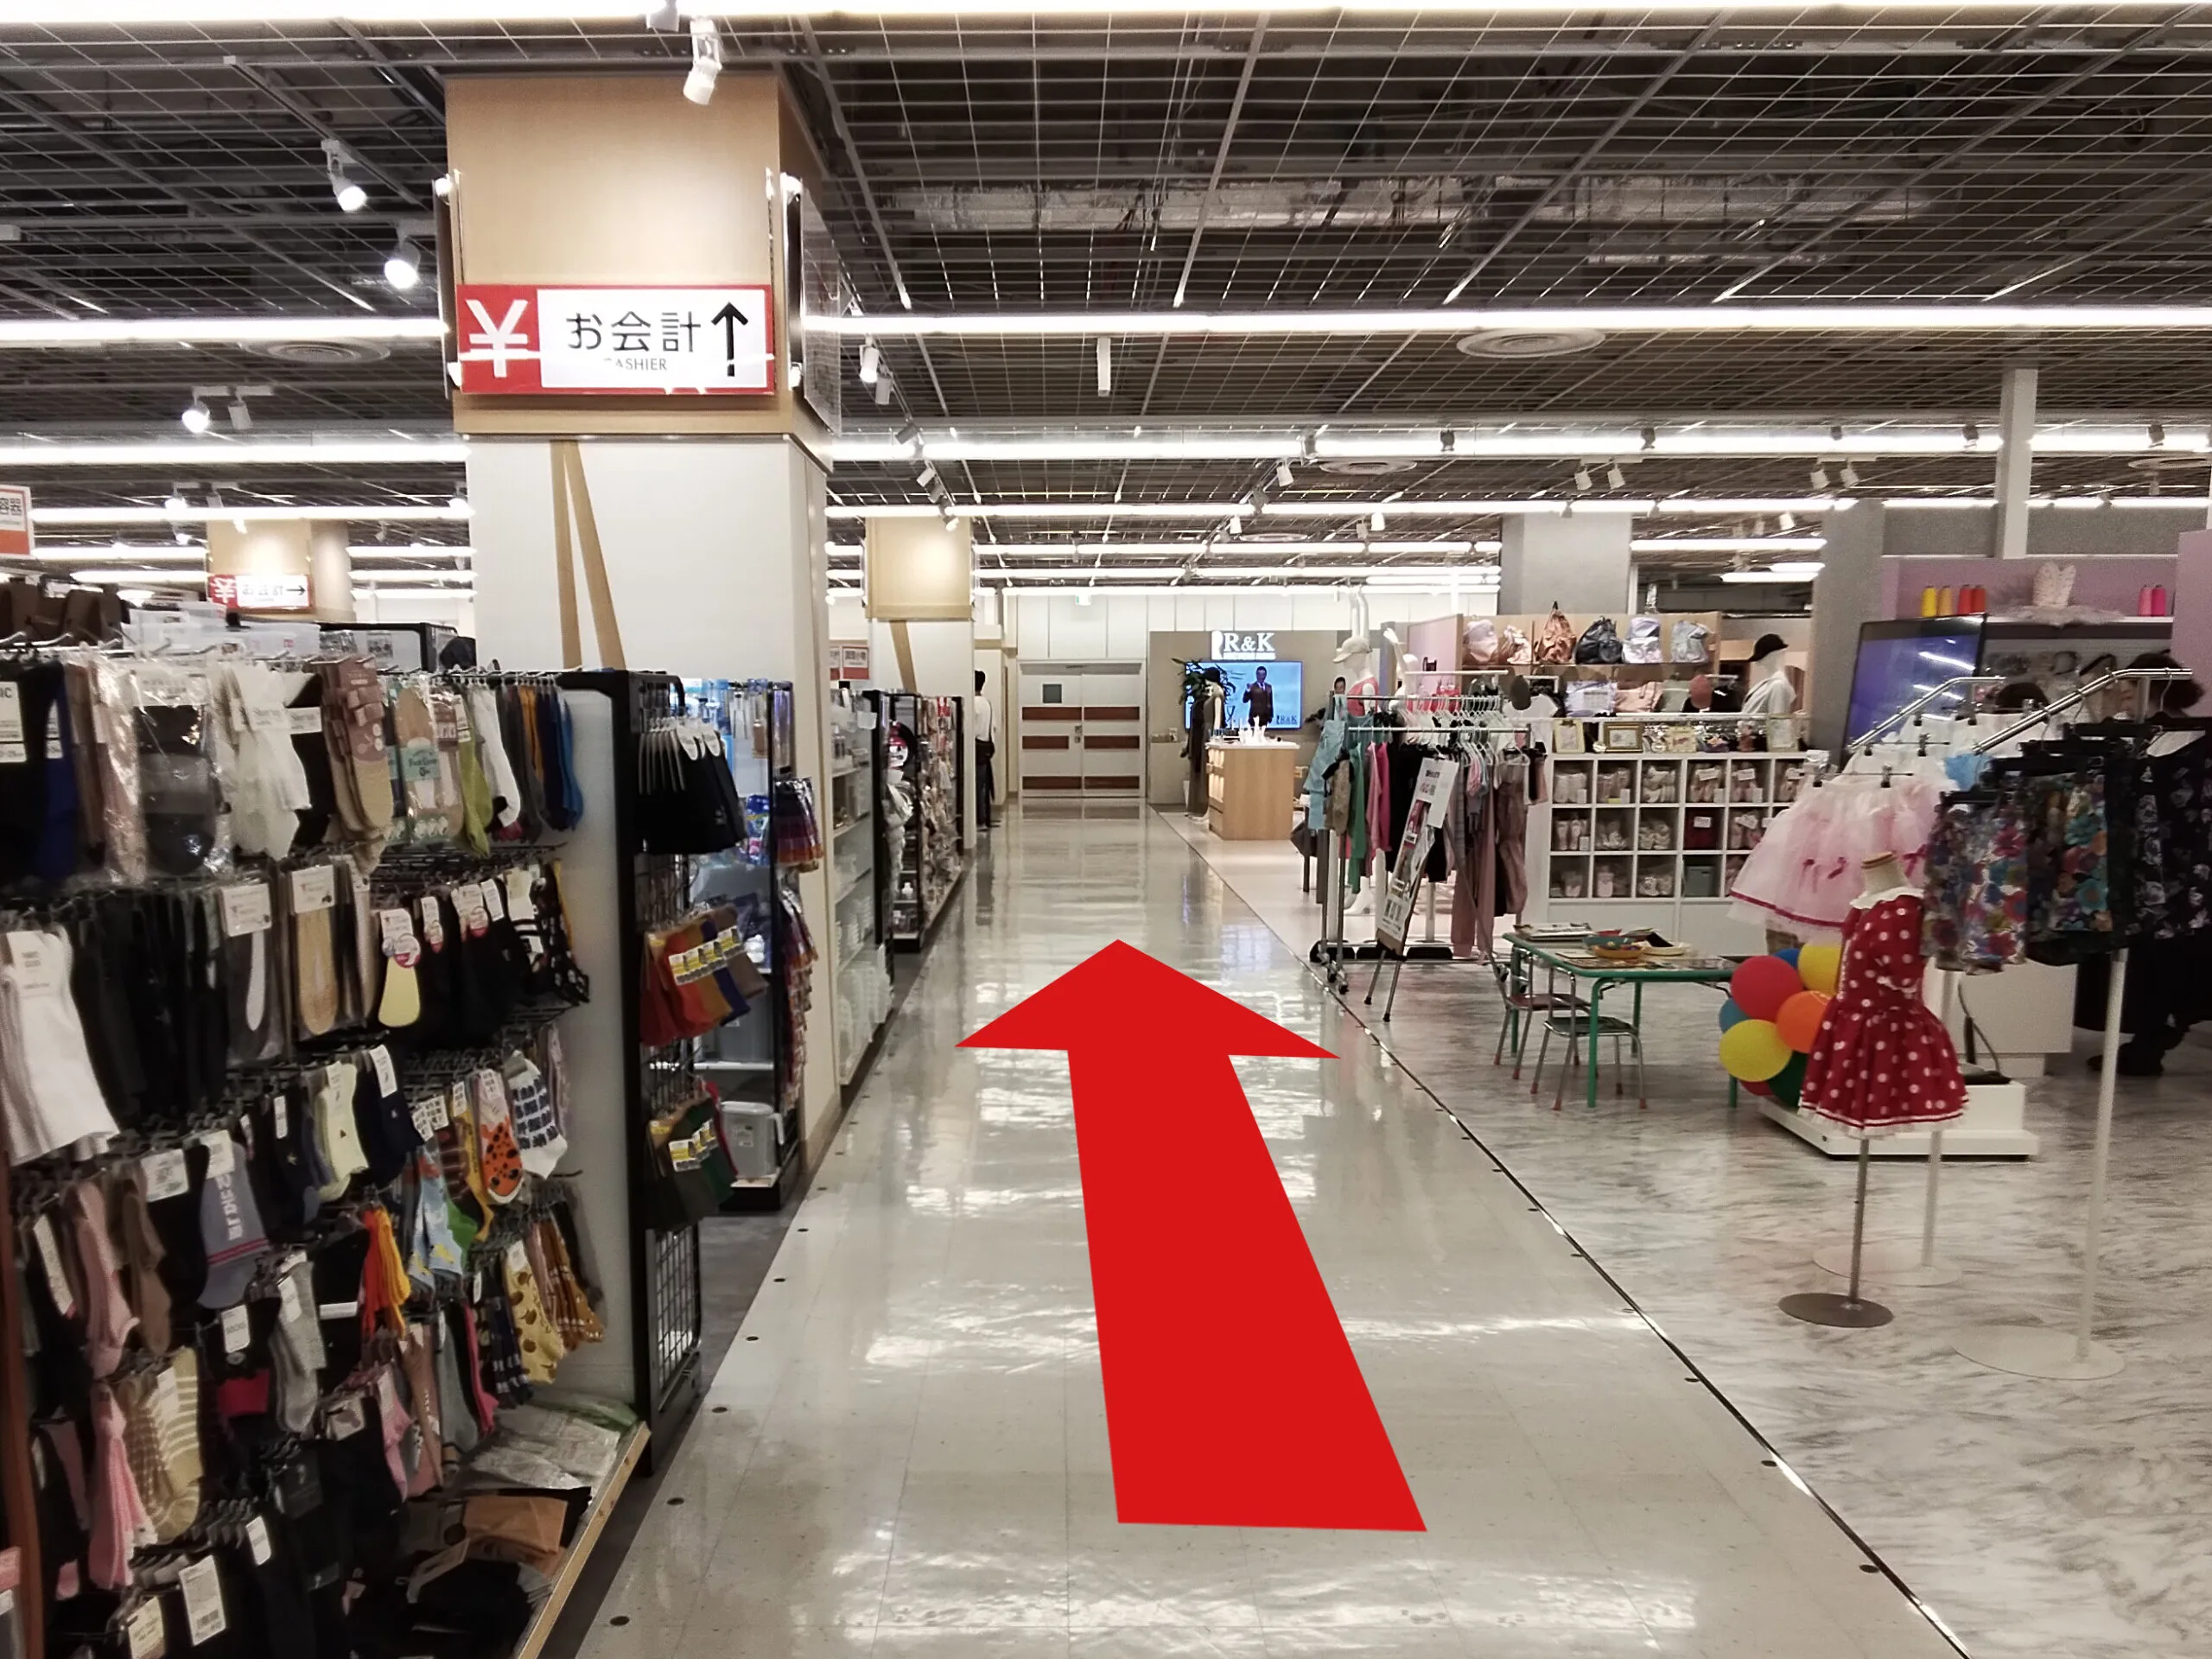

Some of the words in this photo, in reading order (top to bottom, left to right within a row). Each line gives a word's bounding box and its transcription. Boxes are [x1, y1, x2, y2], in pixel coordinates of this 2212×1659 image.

[566, 311, 702, 353] お会計
[1223, 632, 1275, 652] R&K
